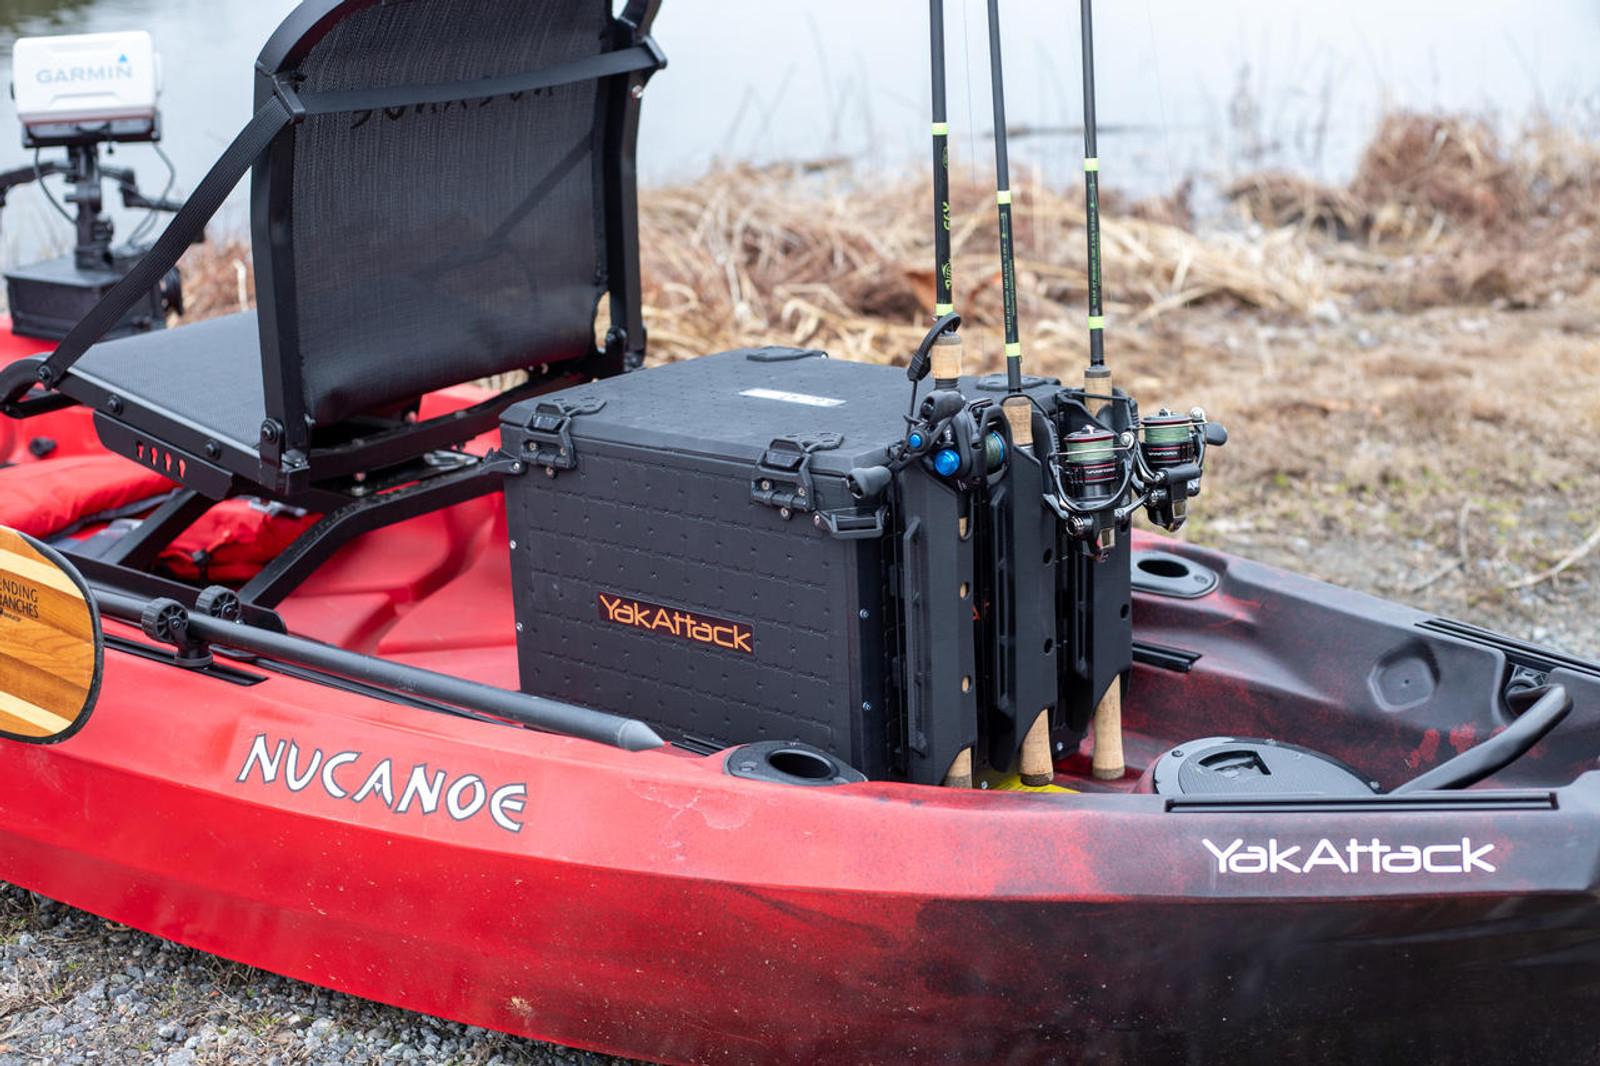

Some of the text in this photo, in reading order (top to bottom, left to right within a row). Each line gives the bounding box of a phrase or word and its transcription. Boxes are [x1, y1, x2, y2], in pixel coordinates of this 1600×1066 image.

[36, 65, 133, 84] GARMIN
[599, 594, 752, 652] YakAttack
[236, 733, 528, 833] NUCANOE
[1201, 837, 1497, 873] YakAttack
